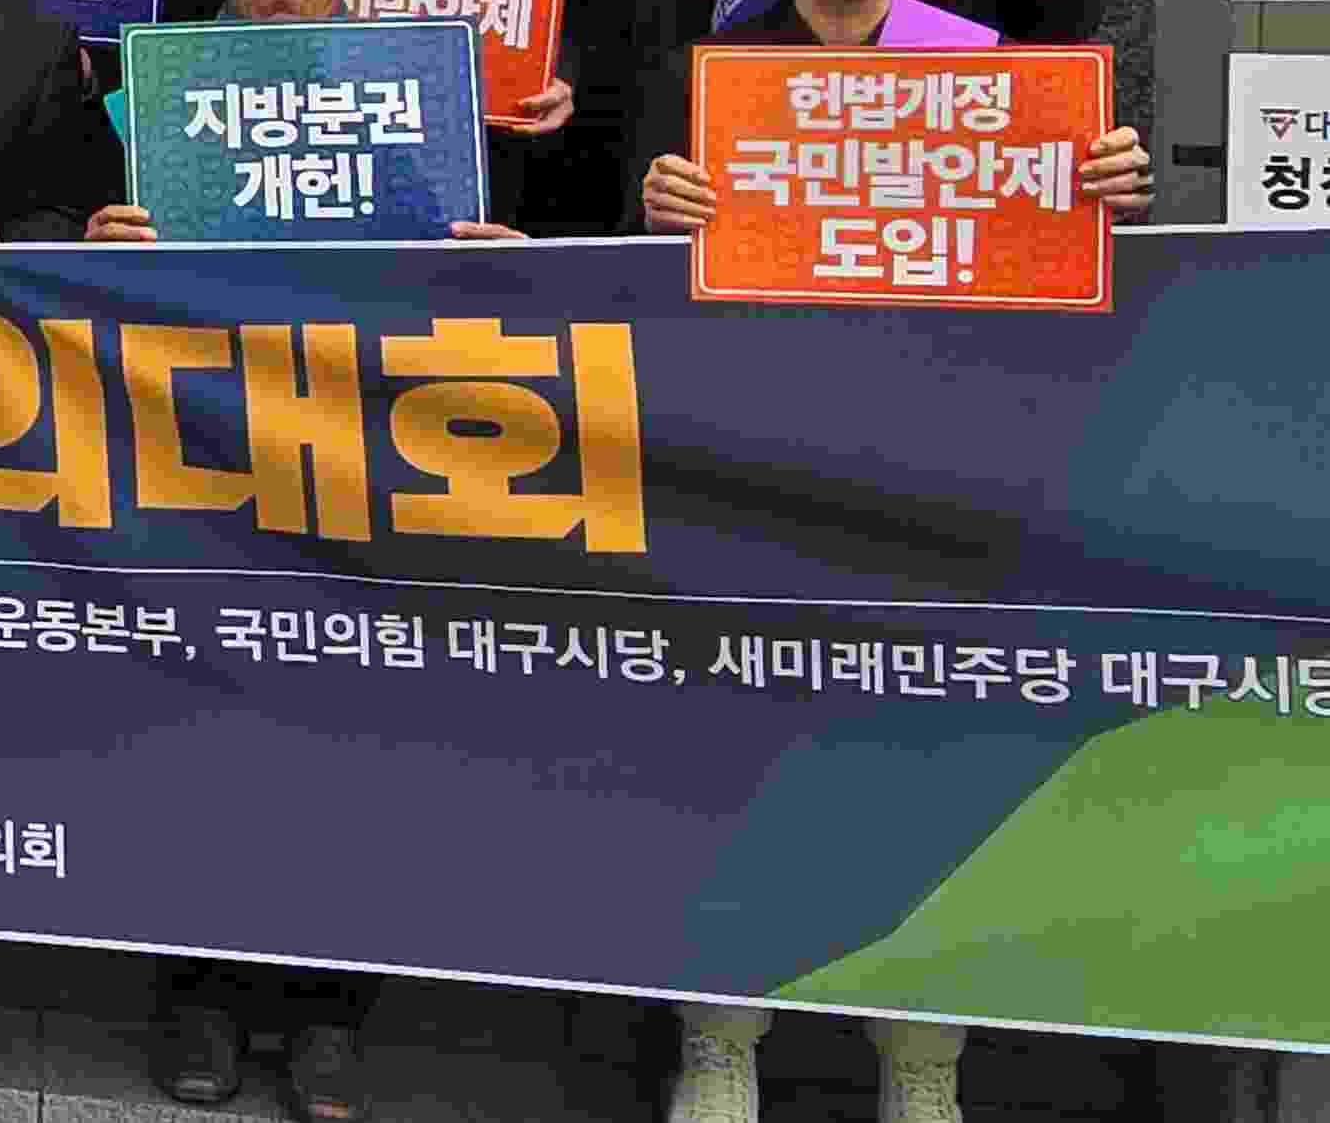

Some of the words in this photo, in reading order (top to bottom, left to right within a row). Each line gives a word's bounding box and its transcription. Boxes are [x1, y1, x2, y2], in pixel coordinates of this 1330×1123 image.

[184, 78, 426, 149] 지방분권
[786, 71, 1013, 133] 헌법개정
[233, 152, 376, 220] 개헌!
[726, 138, 1075, 213] 국민발안제
[812, 216, 976, 288] 도입!
[215, 606, 426, 670] 국민의힘
[447, 618, 686, 686] 대구시당,
[707, 634, 1077, 704] 새미래민주당
